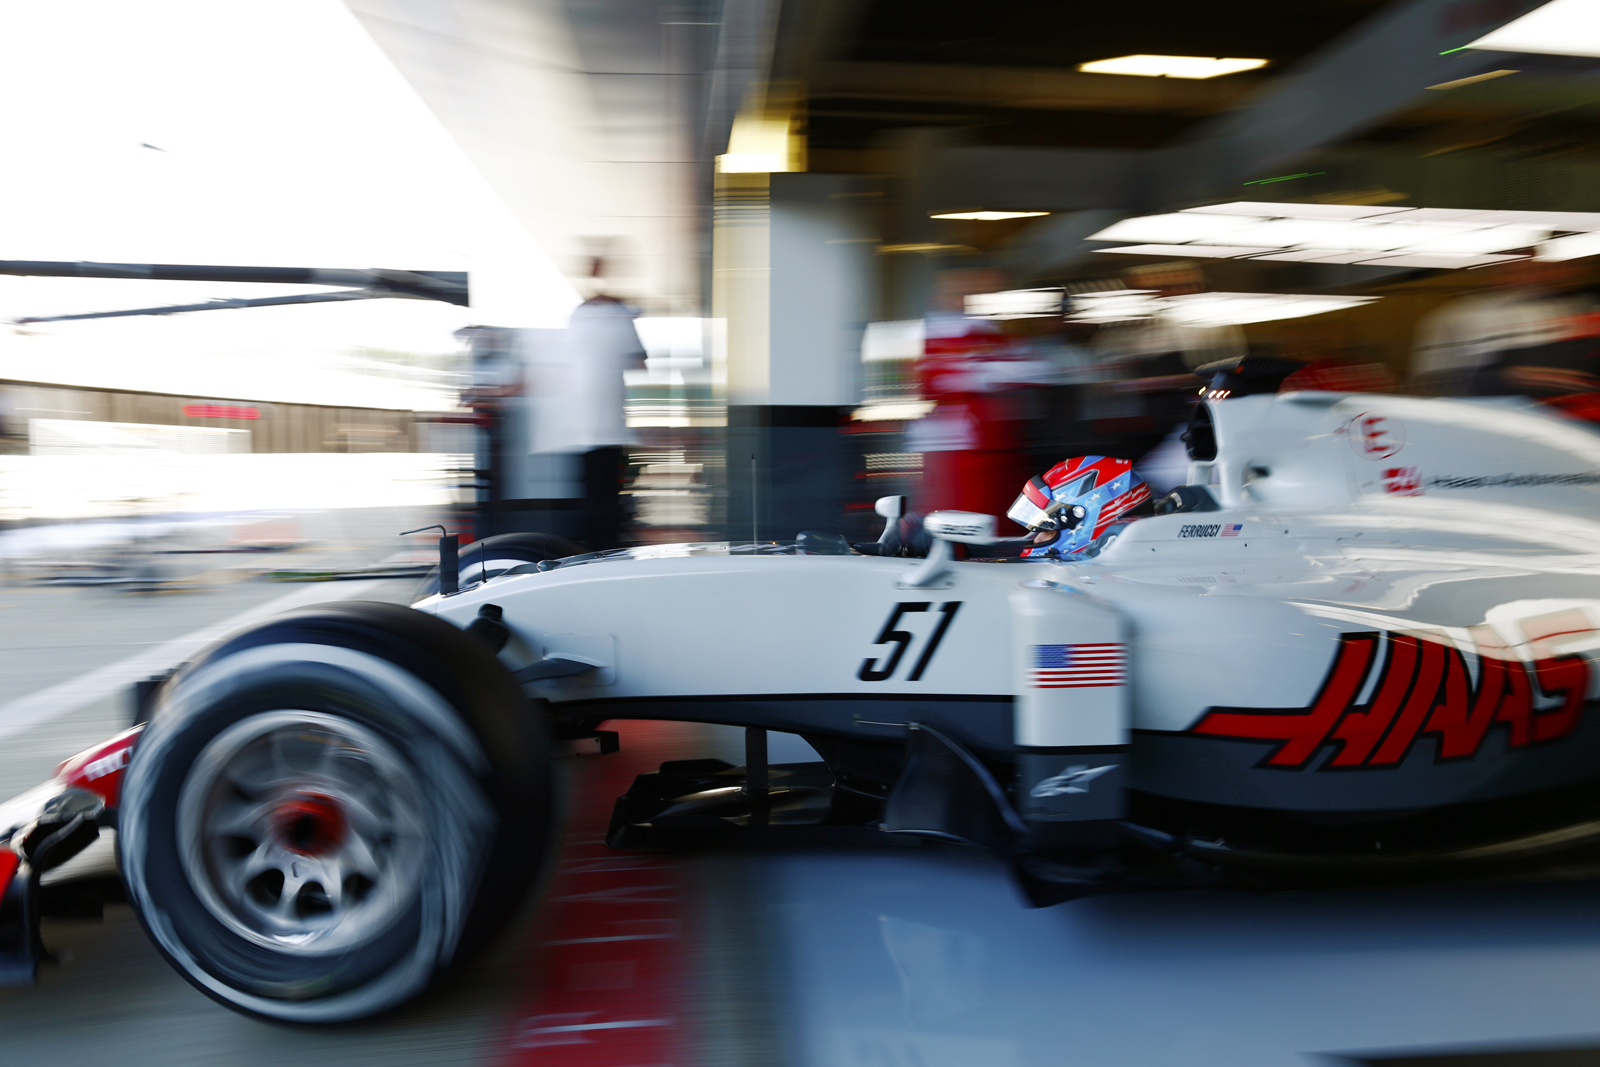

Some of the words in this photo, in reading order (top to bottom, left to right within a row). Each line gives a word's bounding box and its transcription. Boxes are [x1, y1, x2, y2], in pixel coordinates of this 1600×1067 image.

[1177, 524, 1221, 538] FERRUCCI
[856, 601, 965, 682] 51
[1185, 620, 1596, 773] HAAS
